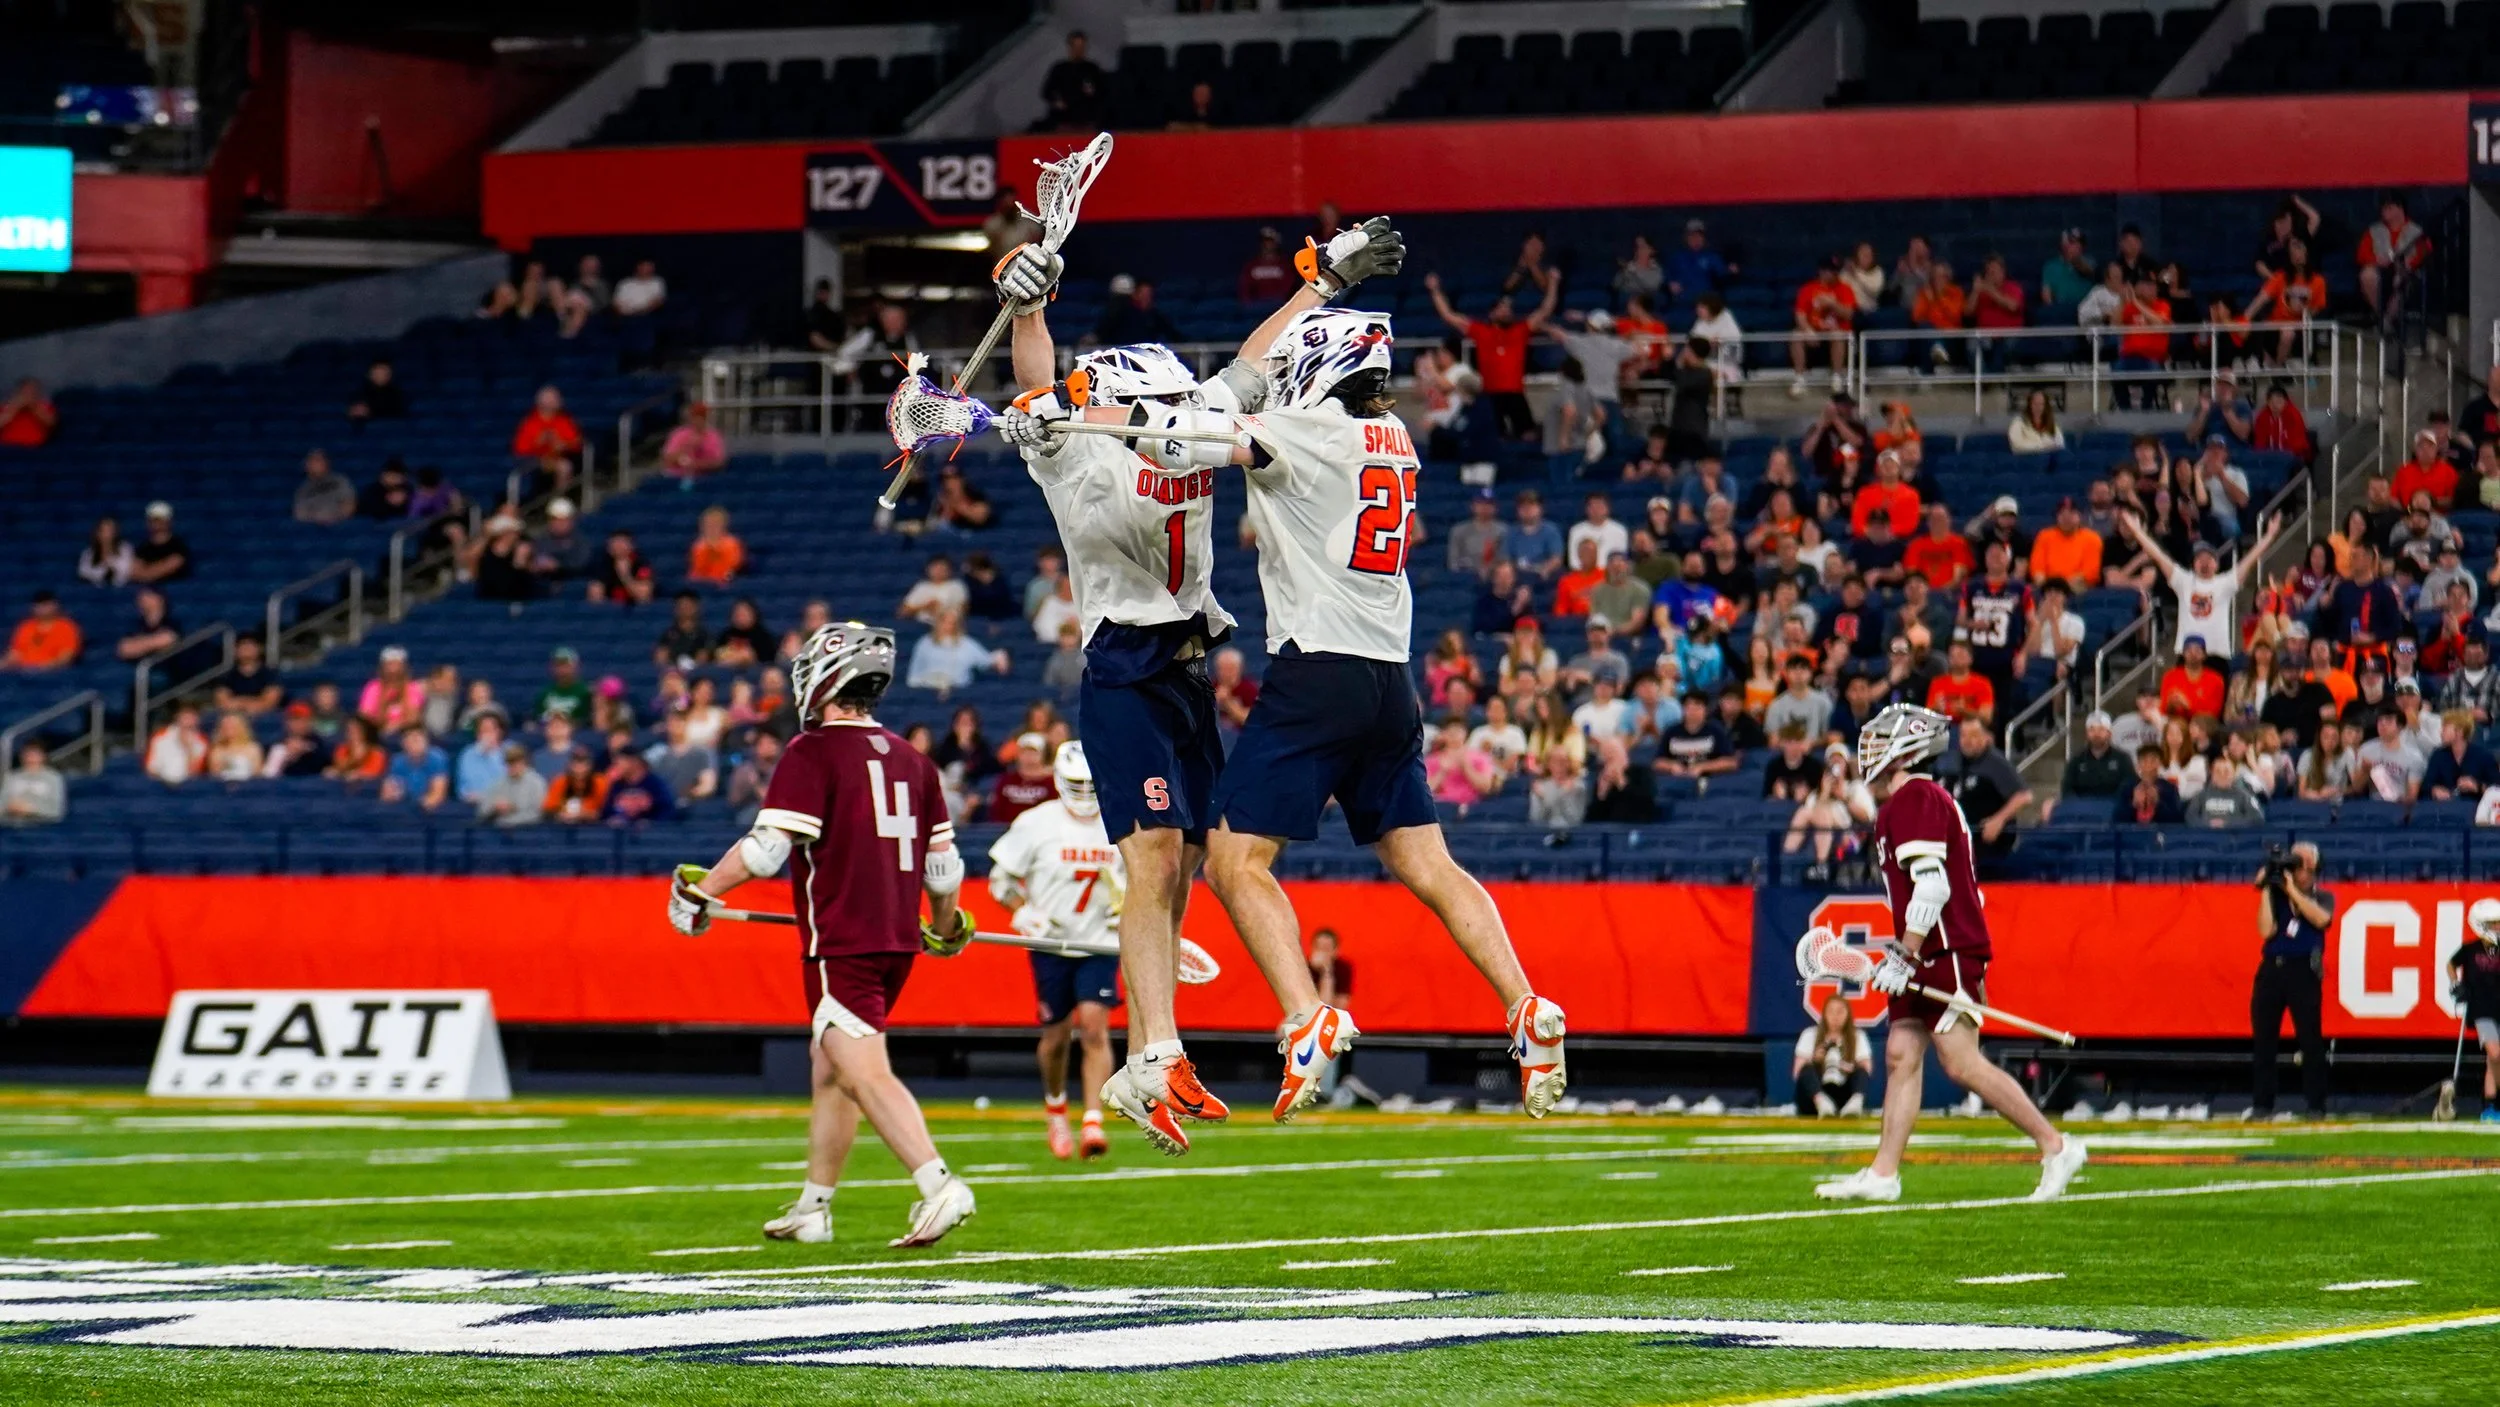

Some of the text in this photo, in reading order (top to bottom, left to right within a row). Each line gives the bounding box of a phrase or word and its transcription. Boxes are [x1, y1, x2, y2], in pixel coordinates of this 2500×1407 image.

[807, 166, 883, 211] 127
[920, 156, 996, 200] 128
[1165, 510, 1187, 596] 1
[867, 760, 917, 871] 4
[1144, 777, 1170, 811] S
[1074, 870, 1101, 913] 7
[183, 1002, 461, 1058] GAIT
[170, 1071, 444, 1091] LACROSSE
